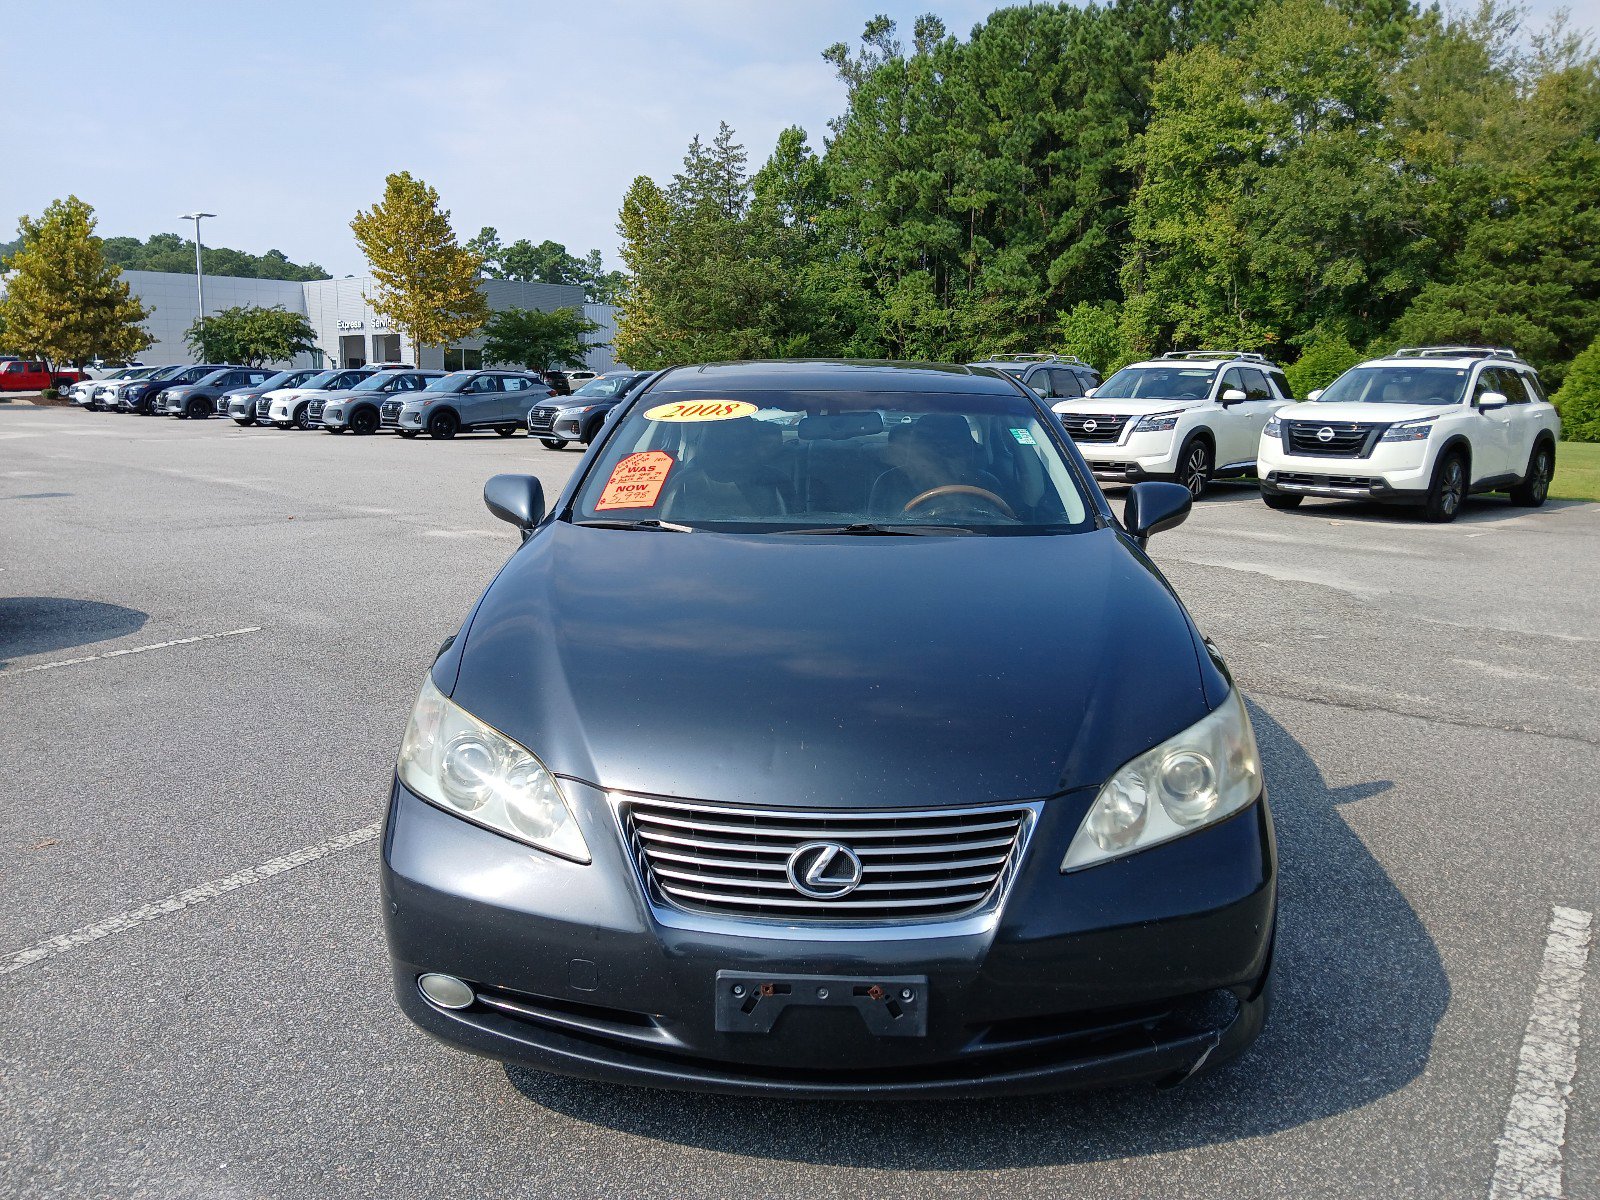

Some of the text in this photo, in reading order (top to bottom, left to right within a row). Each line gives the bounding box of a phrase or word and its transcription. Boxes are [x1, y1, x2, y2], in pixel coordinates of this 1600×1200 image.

[336, 320, 361, 330] Express
[661, 403, 740, 418] 2008
[627, 465, 656, 473] WAS
[615, 484, 649, 492] NOW
